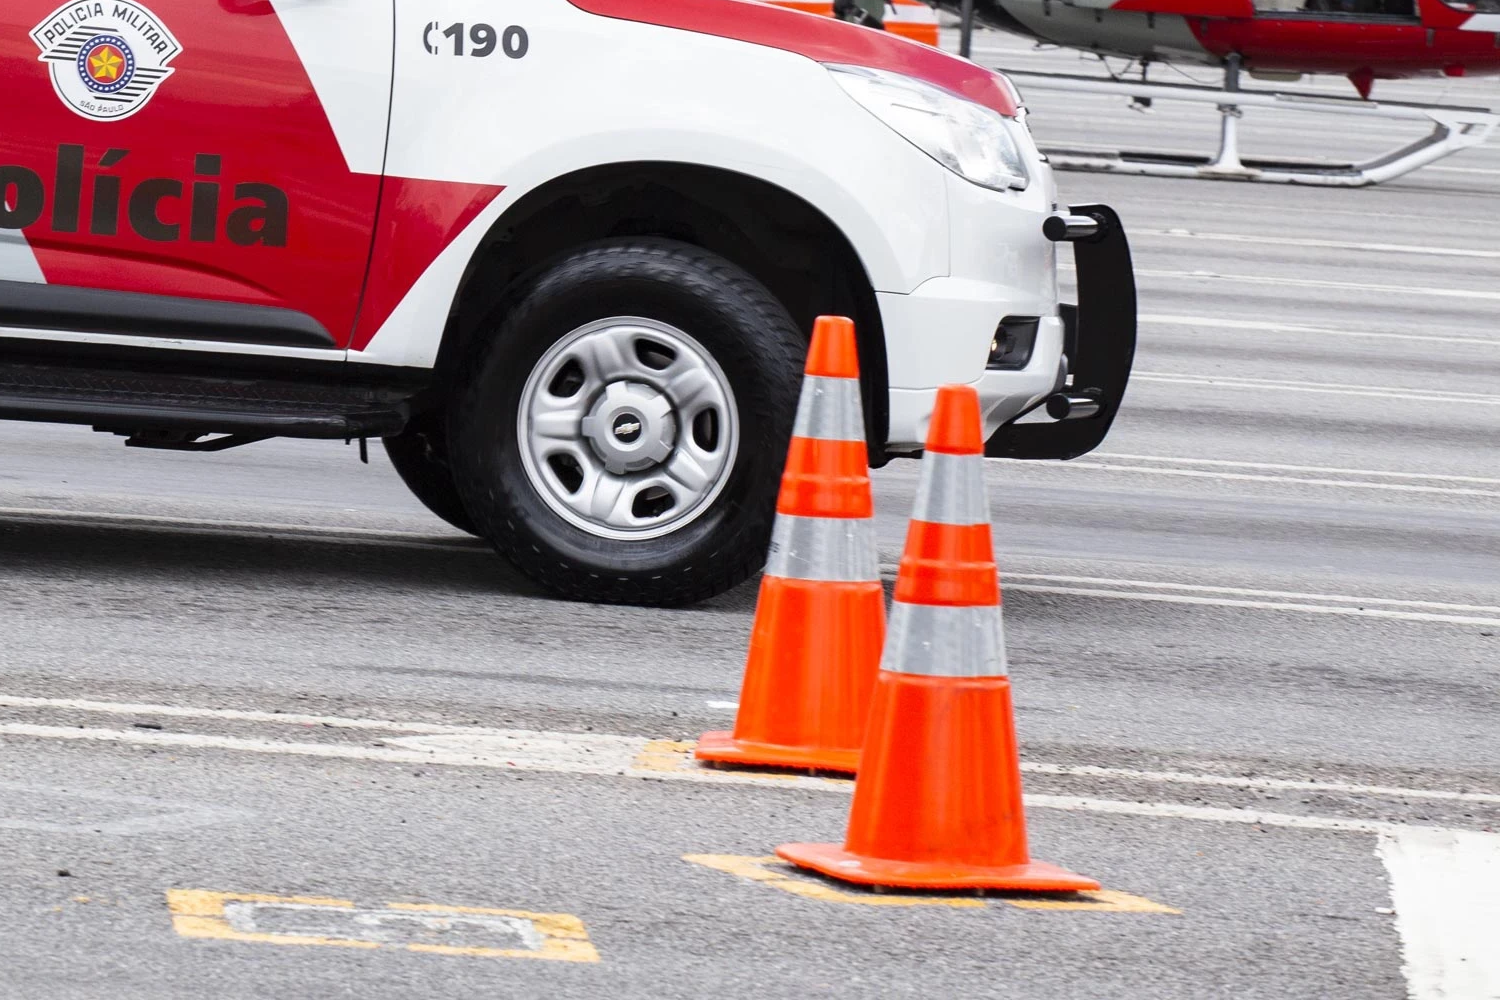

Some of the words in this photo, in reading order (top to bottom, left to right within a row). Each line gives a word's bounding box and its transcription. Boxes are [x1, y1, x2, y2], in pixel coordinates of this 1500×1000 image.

[112, 4, 169, 55] MILITAR
[441, 21, 530, 60] 190
[97, 103, 125, 113] PAULO
